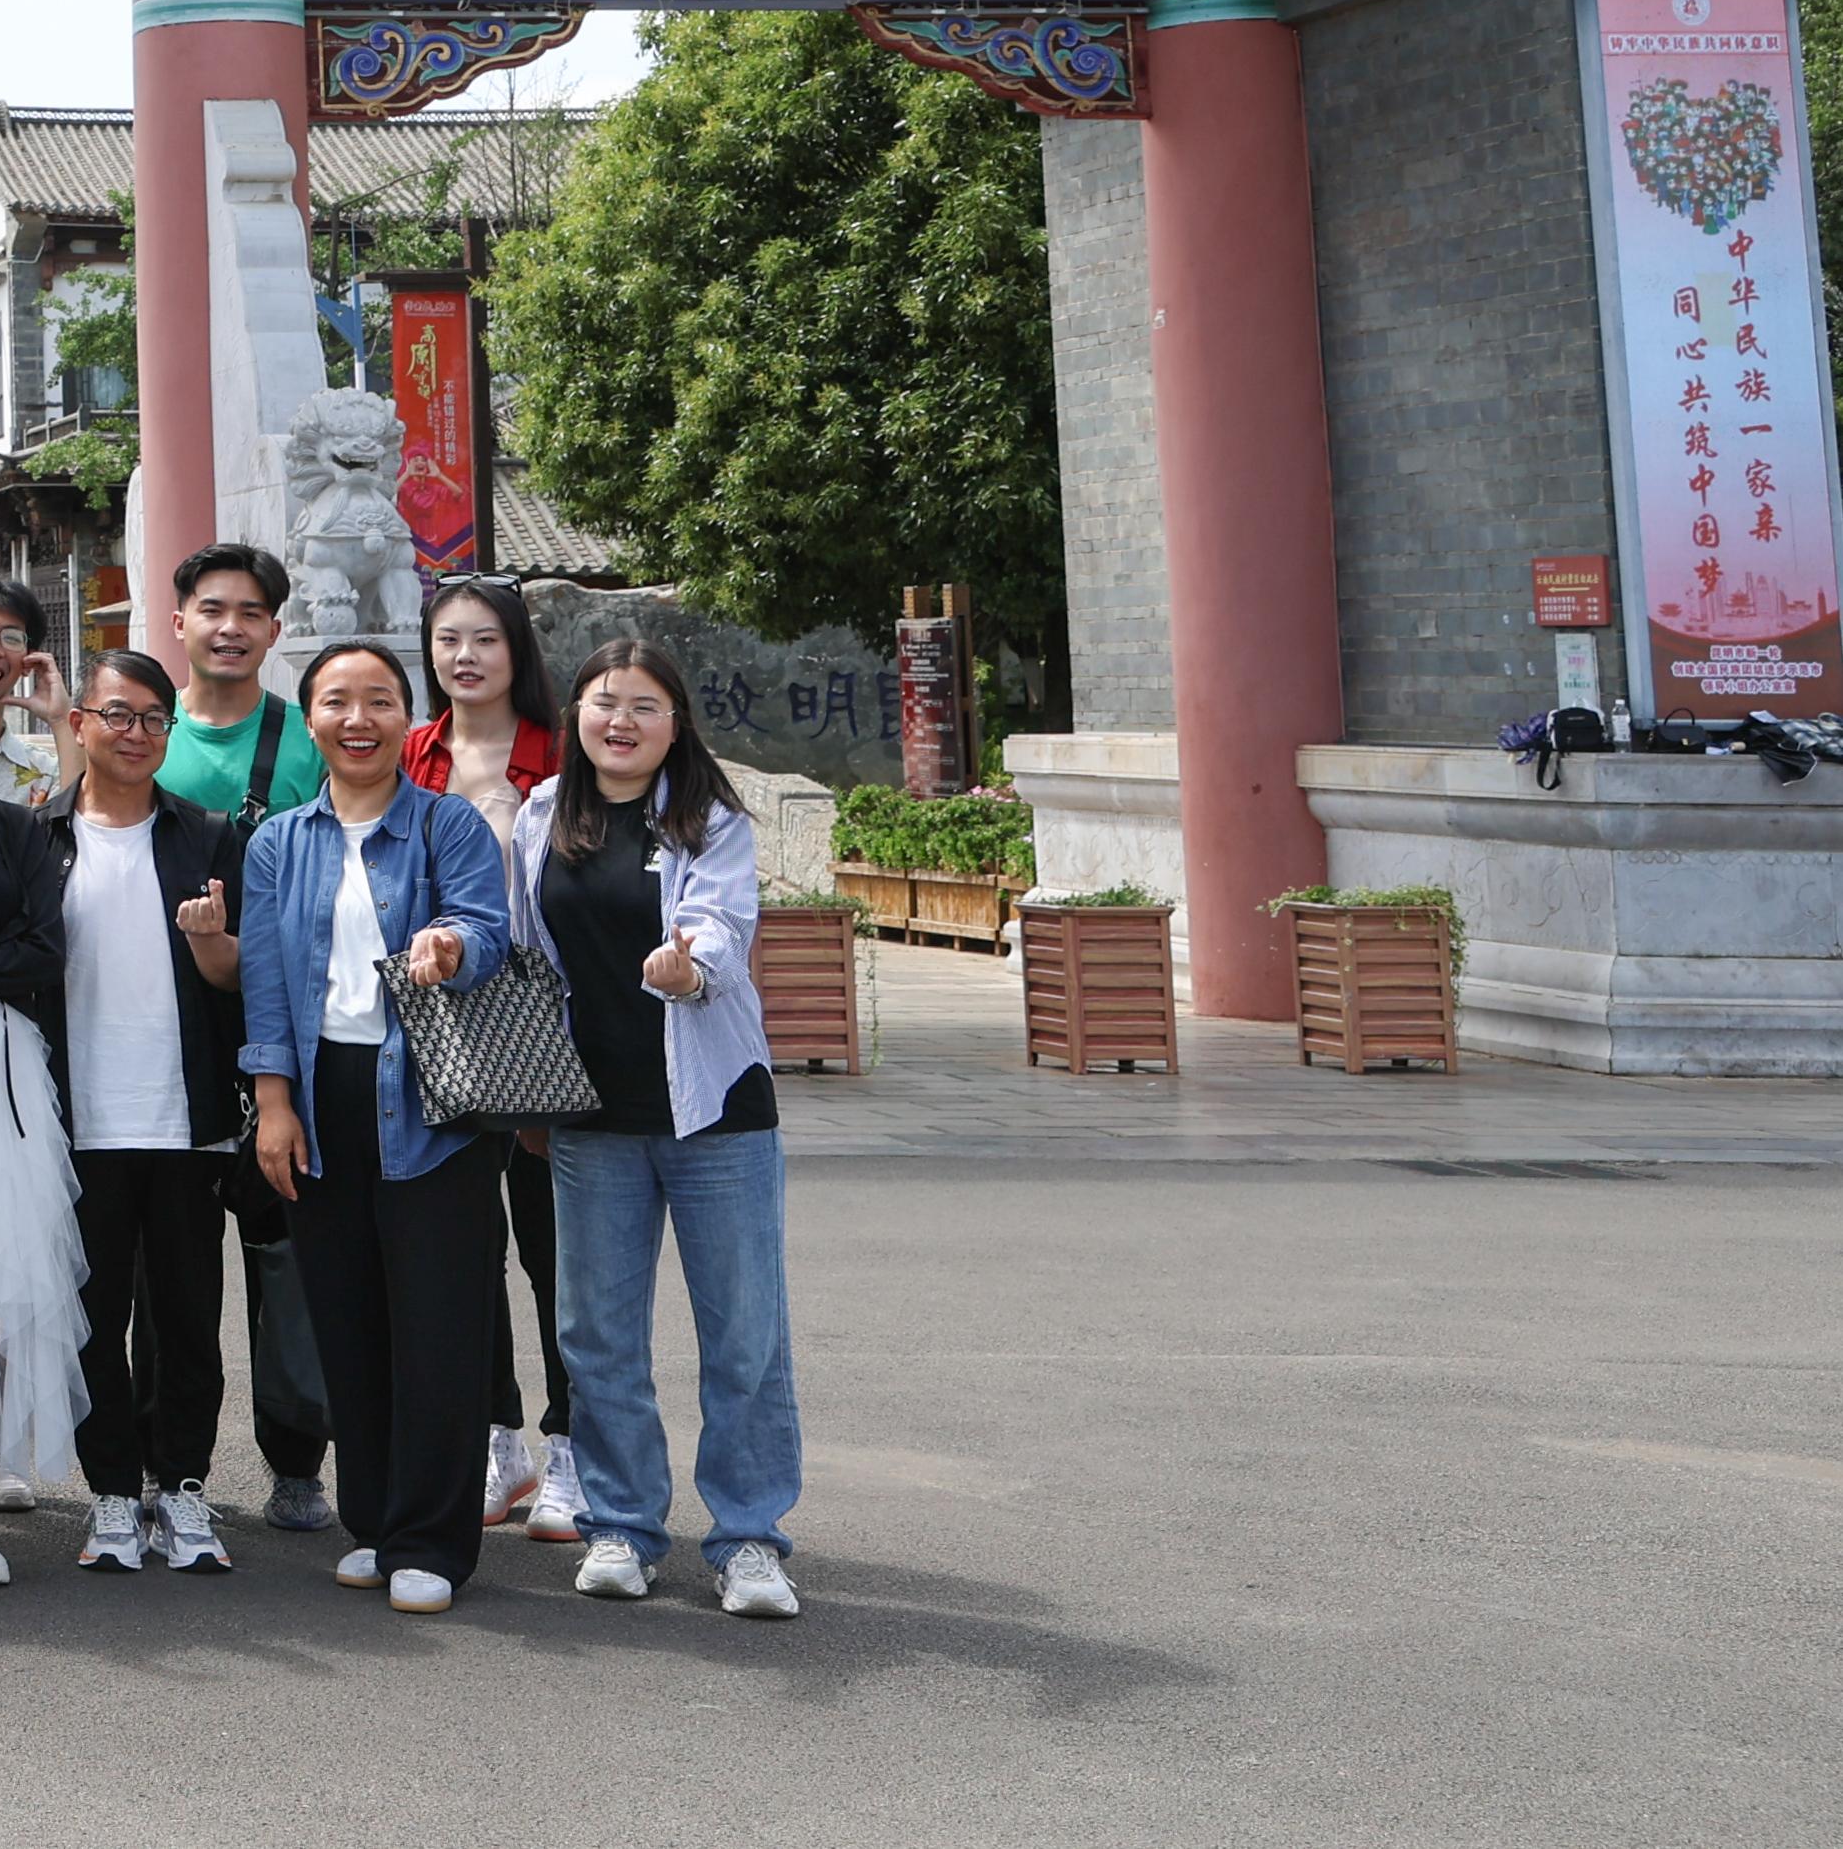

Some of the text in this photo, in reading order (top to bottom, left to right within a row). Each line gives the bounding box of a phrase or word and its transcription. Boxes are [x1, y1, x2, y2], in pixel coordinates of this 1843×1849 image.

[1609, 35, 1780, 50] 铸牢中华民族共同体意识
[1727, 229, 1782, 543] 中华民族一家亲
[443, 380, 457, 466] 不能错过的精彩
[1673, 286, 1723, 599] 同心共筑中国梦
[1671, 662, 1823, 677] 创建全国民族团结进步示范市
[1710, 645, 1782, 660] 昆明市新一轮
